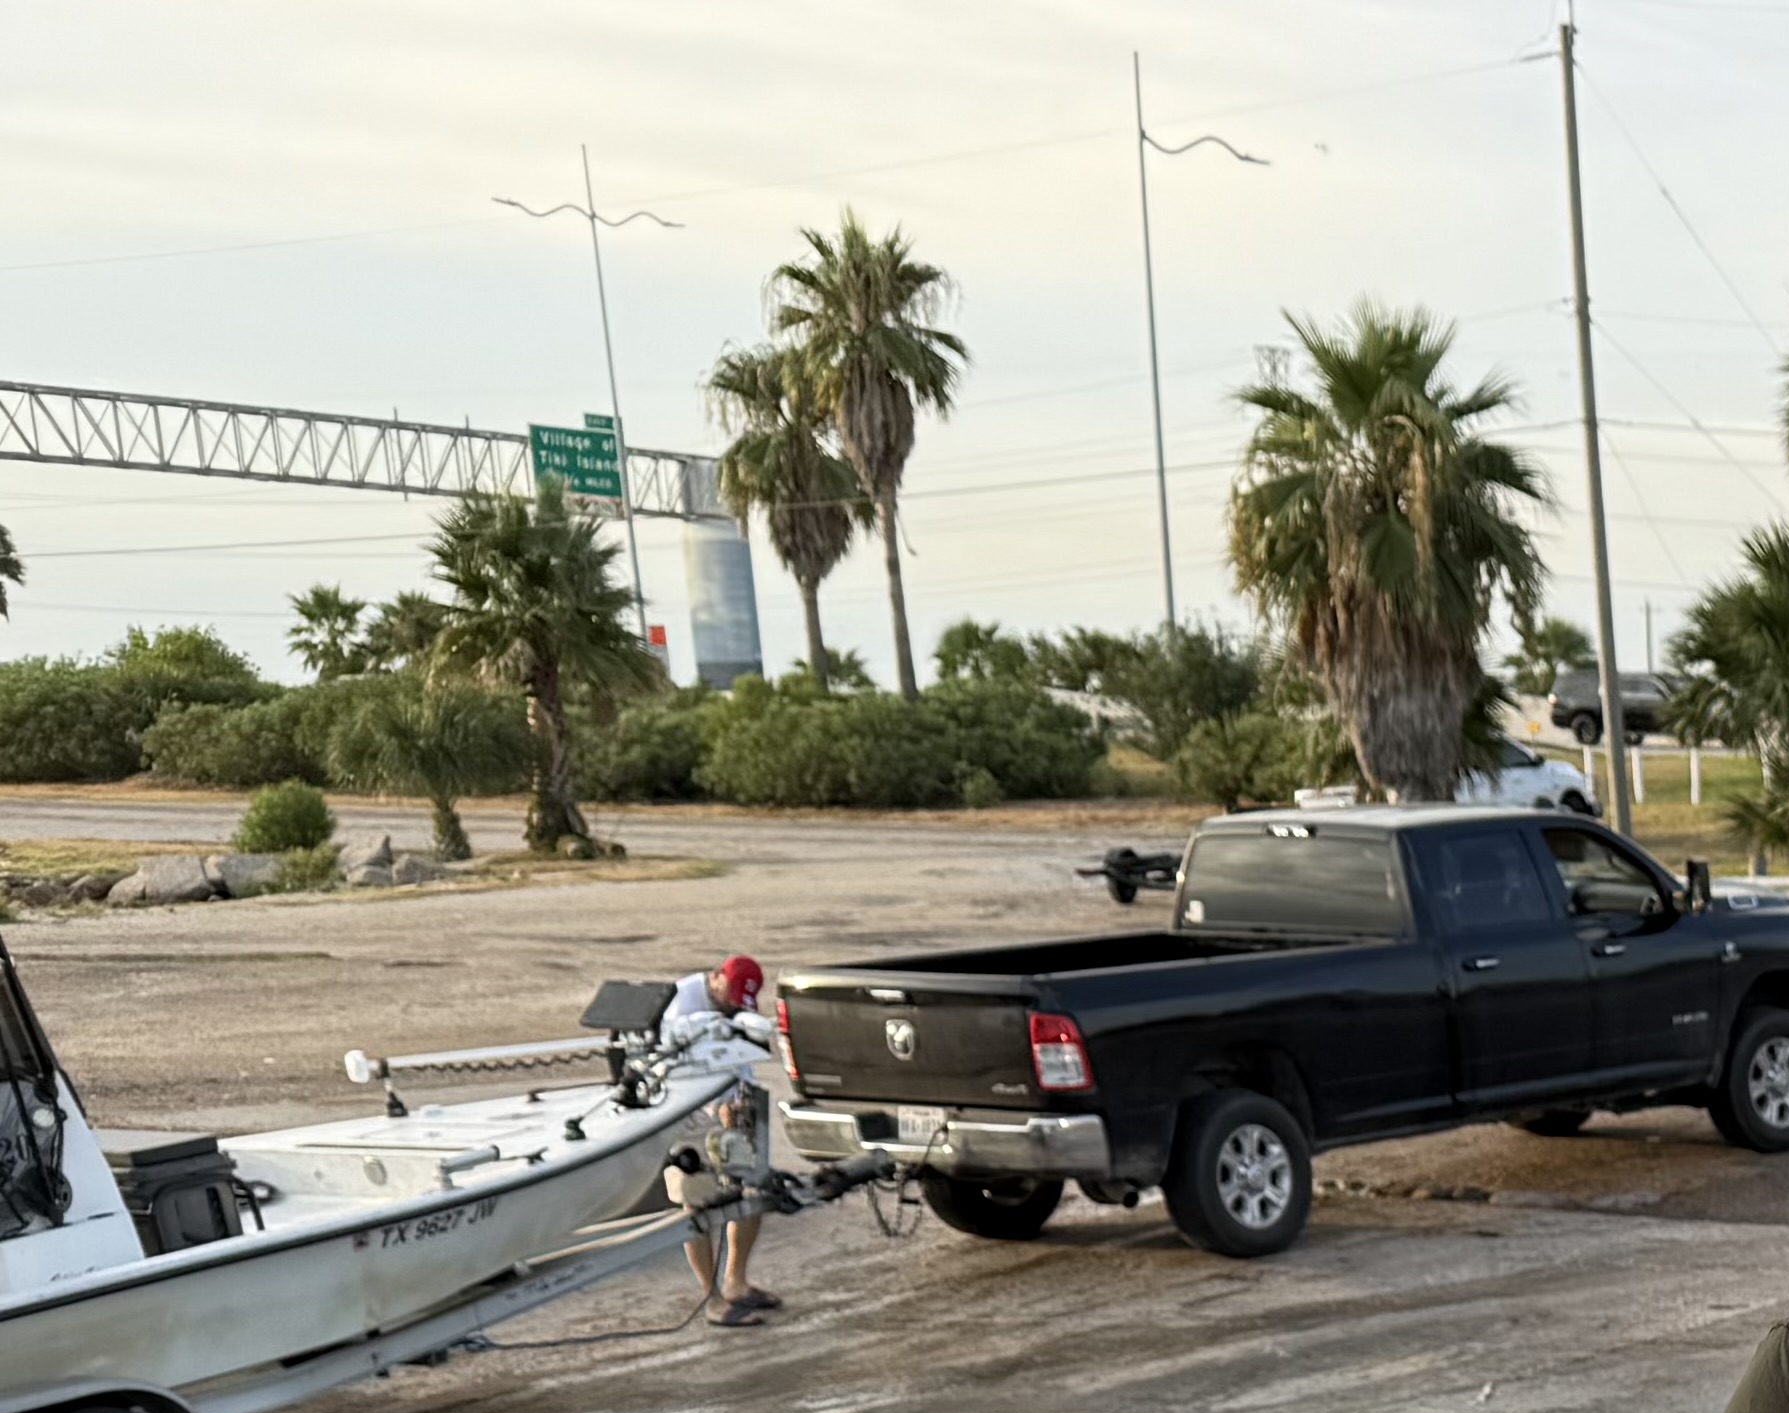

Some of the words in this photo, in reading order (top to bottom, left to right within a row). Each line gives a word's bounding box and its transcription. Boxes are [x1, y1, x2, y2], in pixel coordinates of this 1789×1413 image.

[540, 430, 591, 451] Village
[601, 437, 615, 453] of
[539, 449, 567, 467] Tiki
[577, 453, 620, 472] Island
[381, 1222, 411, 1248] TX
